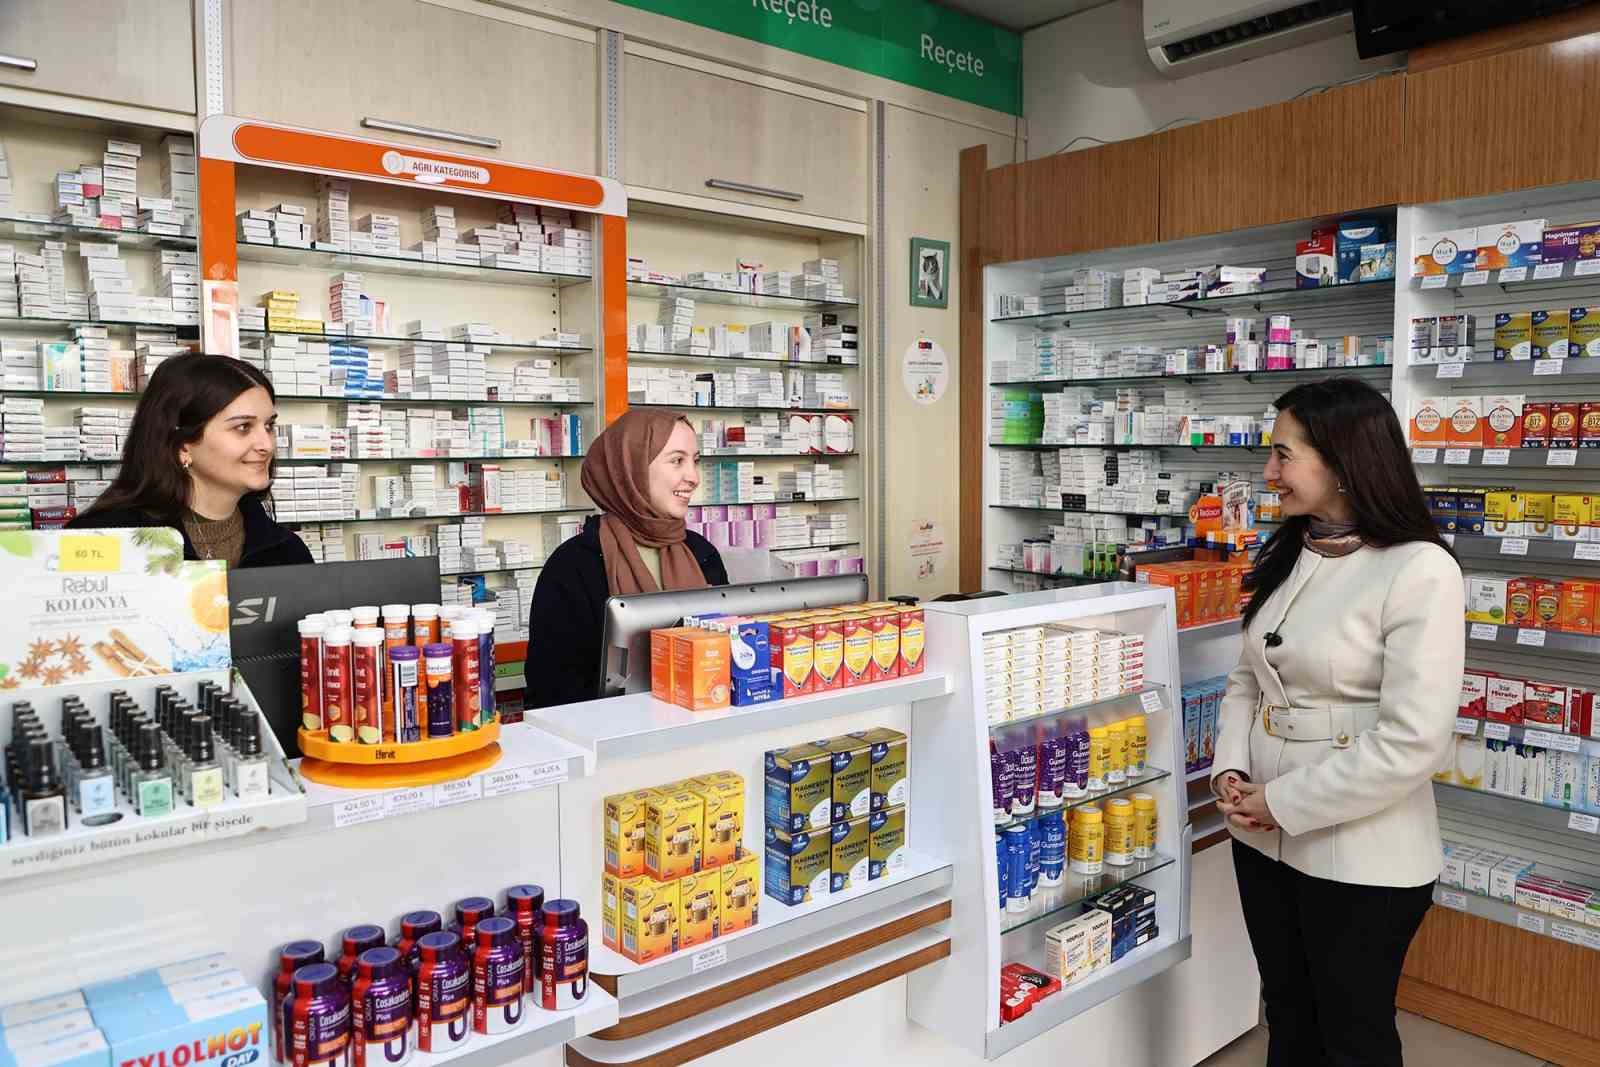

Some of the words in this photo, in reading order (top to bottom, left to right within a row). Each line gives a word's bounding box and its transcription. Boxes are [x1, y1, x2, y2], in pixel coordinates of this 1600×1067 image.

[921, 33, 984, 77] Reçete
[1562, 237, 1579, 245] Plus
[1556, 417, 1569, 425] B12
[91, 550, 104, 558] TL
[62, 576, 109, 593] Rebul
[45, 596, 128, 612] KOLONYA
[136, 825, 187, 842] kokular
[191, 820, 212, 833] bir
[226, 1051, 253, 1067] DAY
